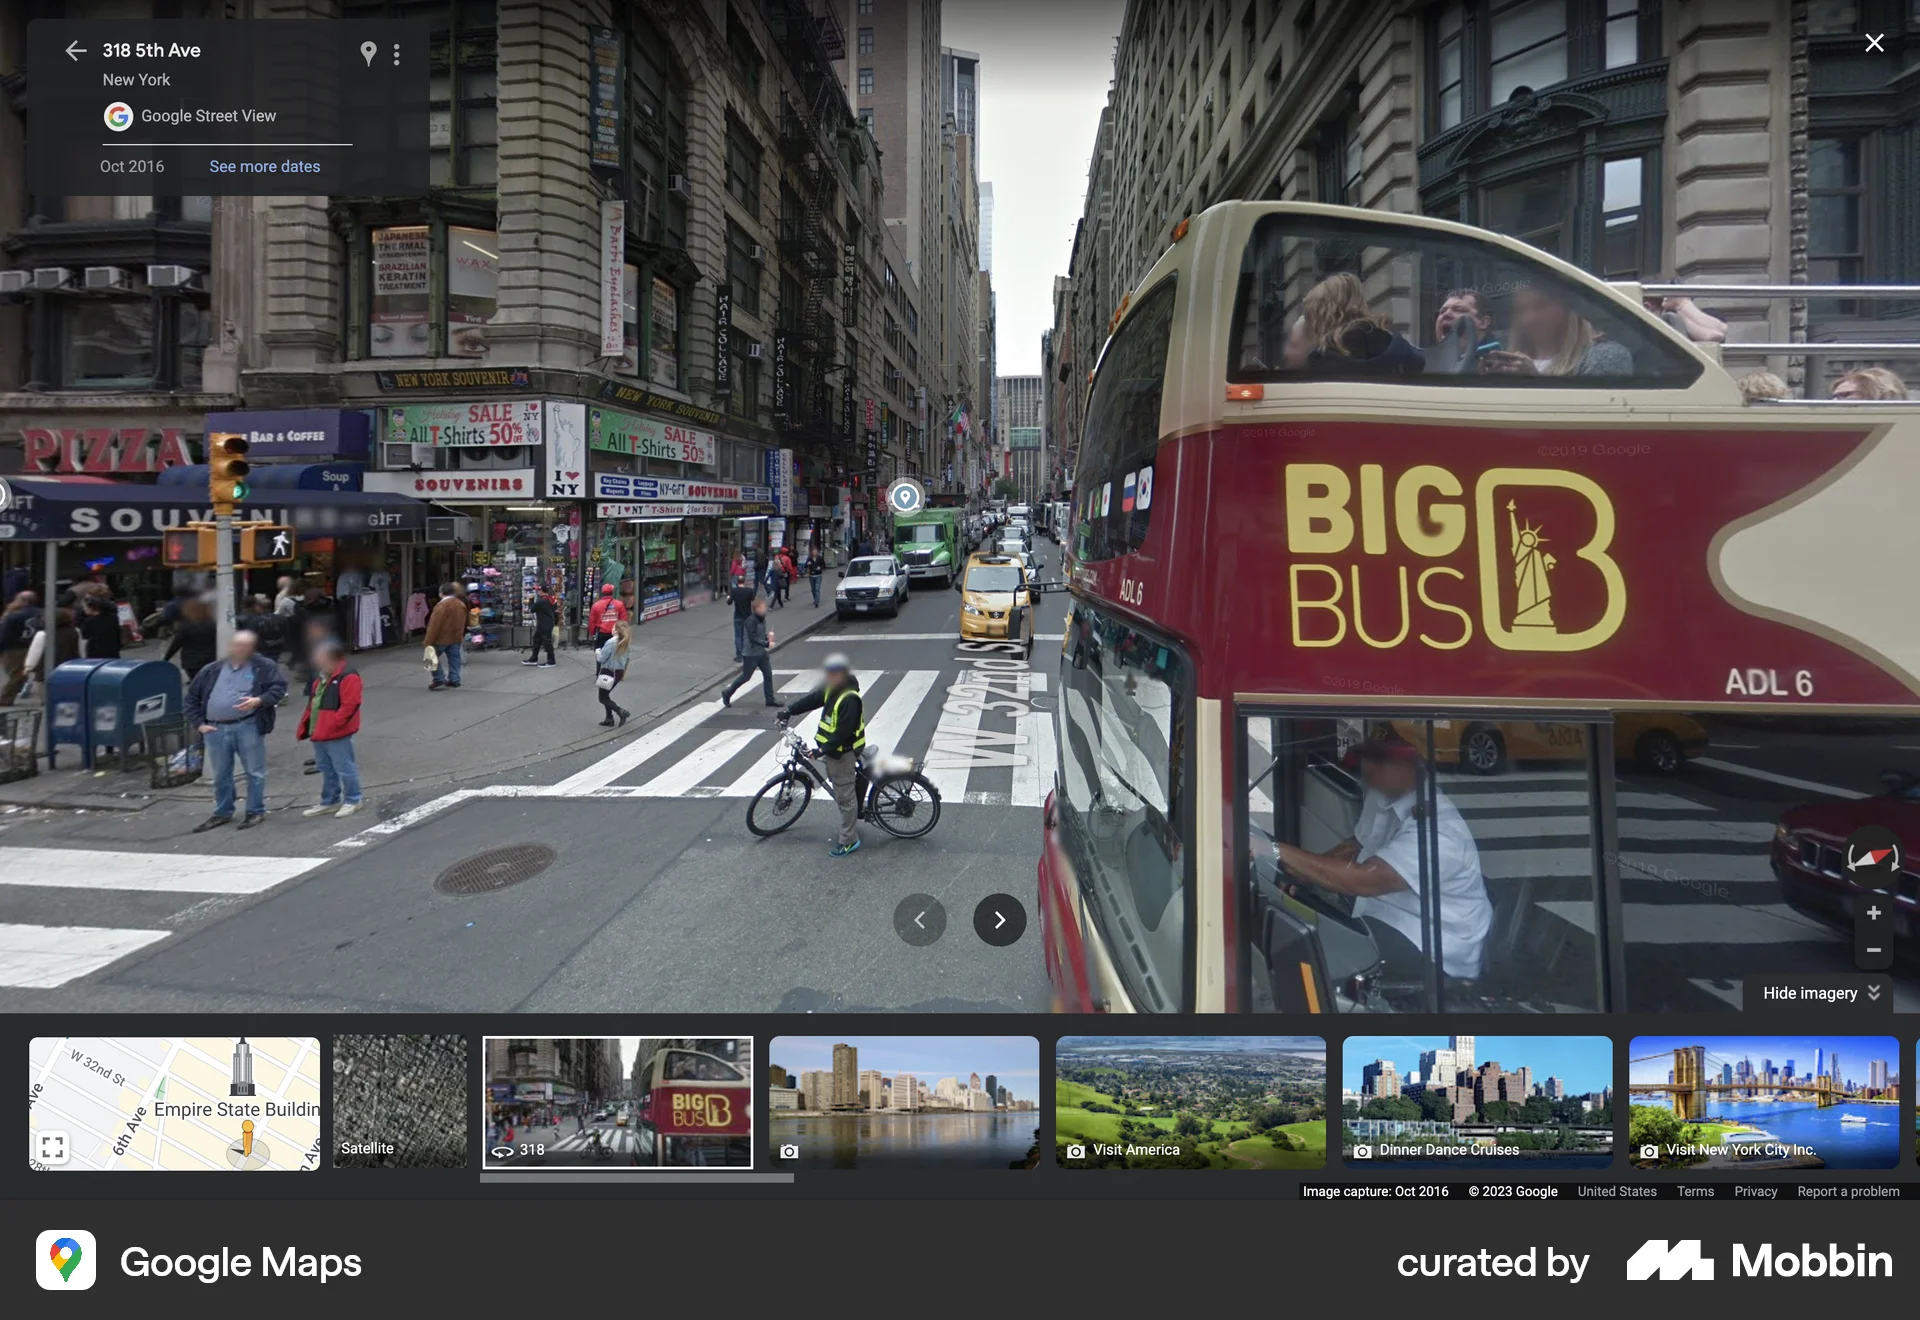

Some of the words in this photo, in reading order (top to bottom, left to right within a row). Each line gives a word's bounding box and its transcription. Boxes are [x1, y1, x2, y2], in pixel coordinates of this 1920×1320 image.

[379, 232, 426, 241] JAPANESE
[379, 242, 426, 251] THERMAL
[379, 263, 426, 271] BRAZILIAN
[455, 256, 492, 269] WAX
[379, 272, 426, 281] KERATIN
[379, 282, 426, 290] TREATMENT
[604, 267, 622, 334] Eyelashes
[718, 295, 728, 325] HAIR
[717, 329, 727, 381] COLLAGE
[776, 337, 785, 361] HAIR
[395, 373, 418, 387] NEW
[420, 372, 451, 386] YORK
[453, 371, 510, 385] SOUVENIR
[776, 364, 785, 406] COLLAGE
[420, 406, 462, 423] Holiday
[468, 403, 513, 423] SALE
[615, 386, 641, 402] NEW
[646, 394, 672, 412] YORK
[676, 405, 720, 424] SOUVENIR
[523, 412, 540, 421] NY
[410, 426, 428, 443] All
[429, 425, 486, 446] T-Shirts
[607, 432, 627, 452] All
[628, 434, 677, 459] T-Shirts
[664, 426, 696, 446] SALE
[22, 428, 193, 472] PIZZA
[322, 470, 349, 484] Soup
[415, 478, 523, 491] SOUVENIRS
[555, 470, 562, 481] I
[551, 484, 579, 495] NY
[687, 484, 738, 499] SOUVENIRS
[651, 506, 684, 515] T-Shirts
[1285, 463, 1467, 557] BIG
[1119, 578, 1135, 604] ADL
[1136, 581, 1143, 606] 6
[1290, 564, 1472, 649] BUS
[1725, 668, 1788, 695] ADL
[1795, 670, 1814, 697] 6
